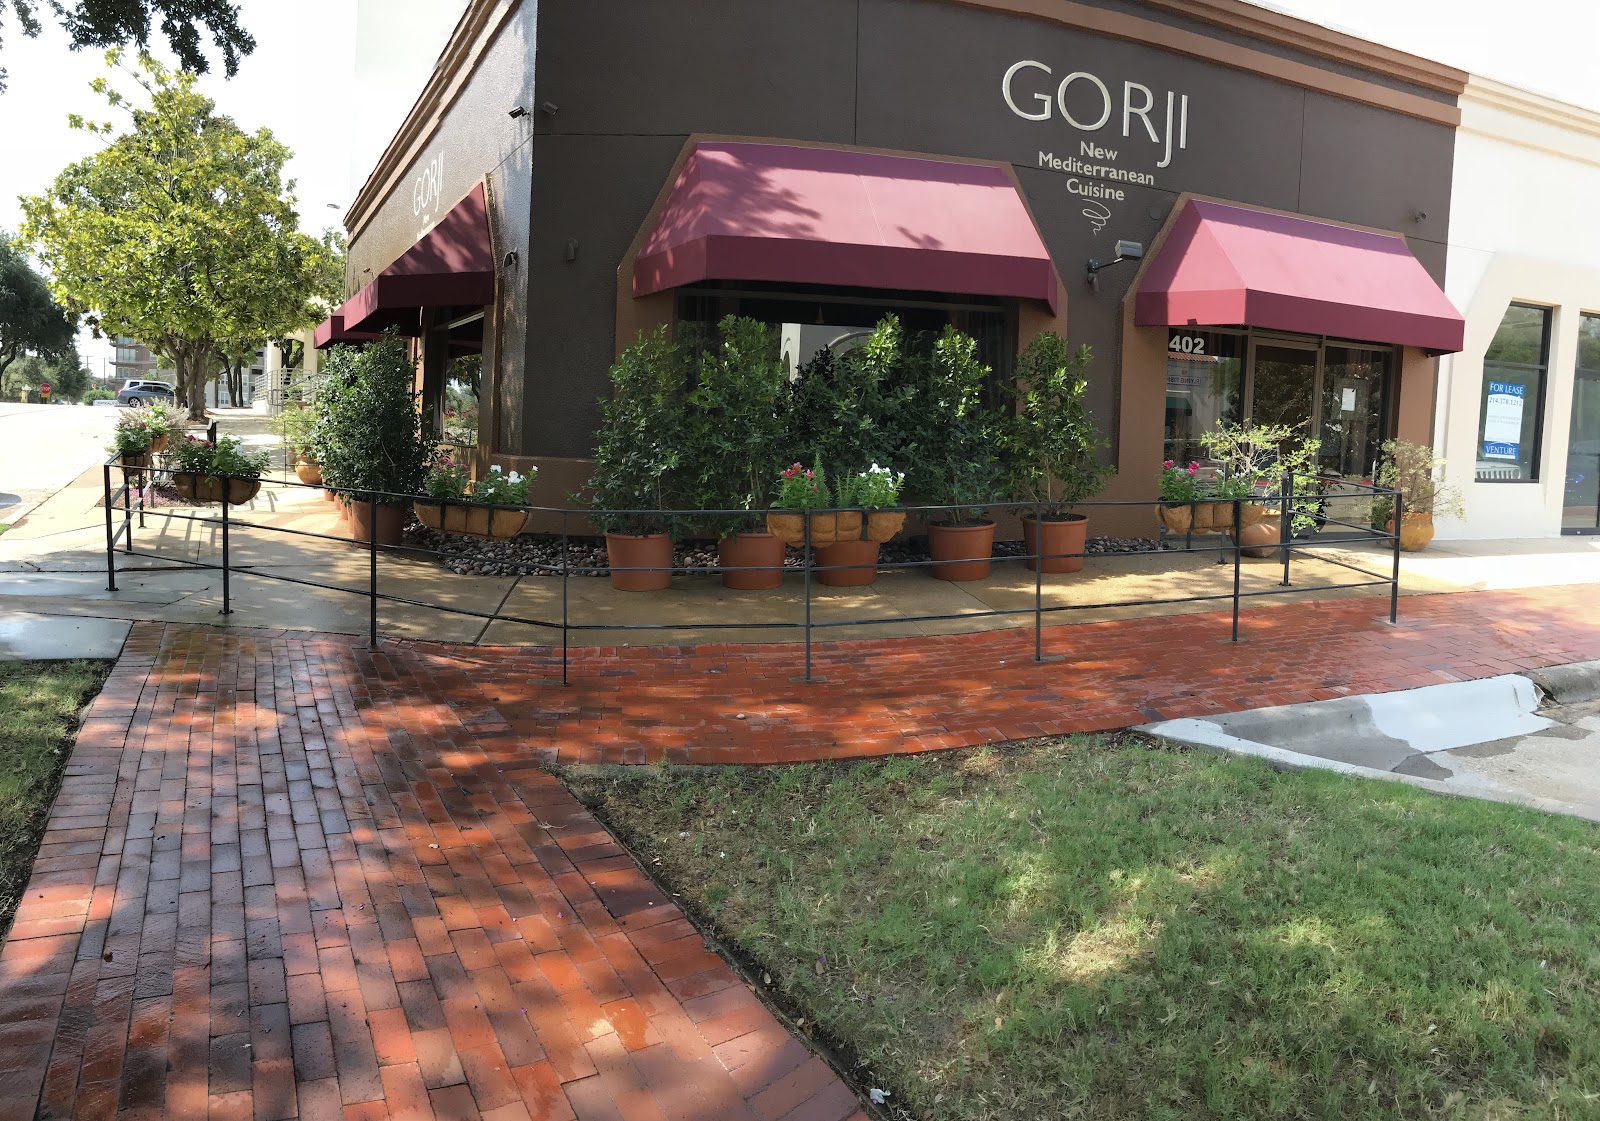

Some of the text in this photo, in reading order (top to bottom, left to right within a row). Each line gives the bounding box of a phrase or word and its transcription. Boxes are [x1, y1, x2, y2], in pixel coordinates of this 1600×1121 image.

[1002, 60, 1188, 168] GORJI
[1080, 141, 1118, 160] New
[1038, 151, 1154, 185] Mediterranean
[413, 150, 443, 216] GORJI
[1066, 178, 1125, 201] Cuisine
[1169, 335, 1204, 354] 402
[1489, 383, 1523, 395] FOR LEASE
[1486, 446, 1516, 455] VENTURE
